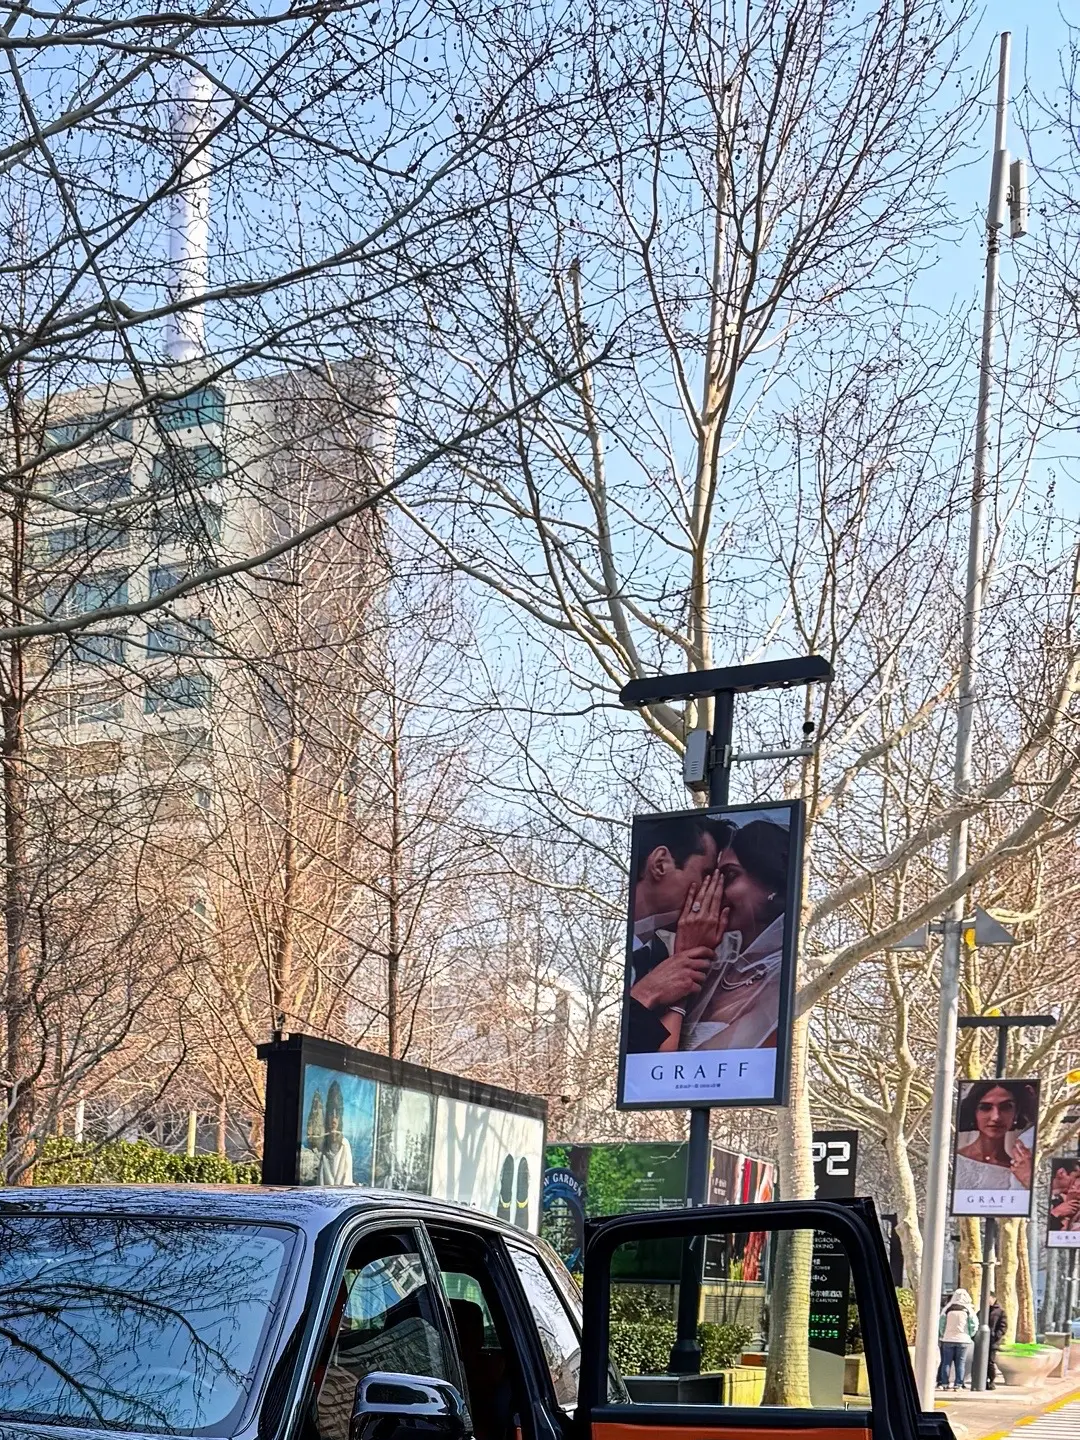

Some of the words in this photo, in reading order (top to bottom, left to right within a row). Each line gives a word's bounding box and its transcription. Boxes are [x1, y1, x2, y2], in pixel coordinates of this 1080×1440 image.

[651, 1062, 749, 1081] GRAFF
[552, 1173, 583, 1197] GARDEN
[967, 1195, 1016, 1204] GRAFF
